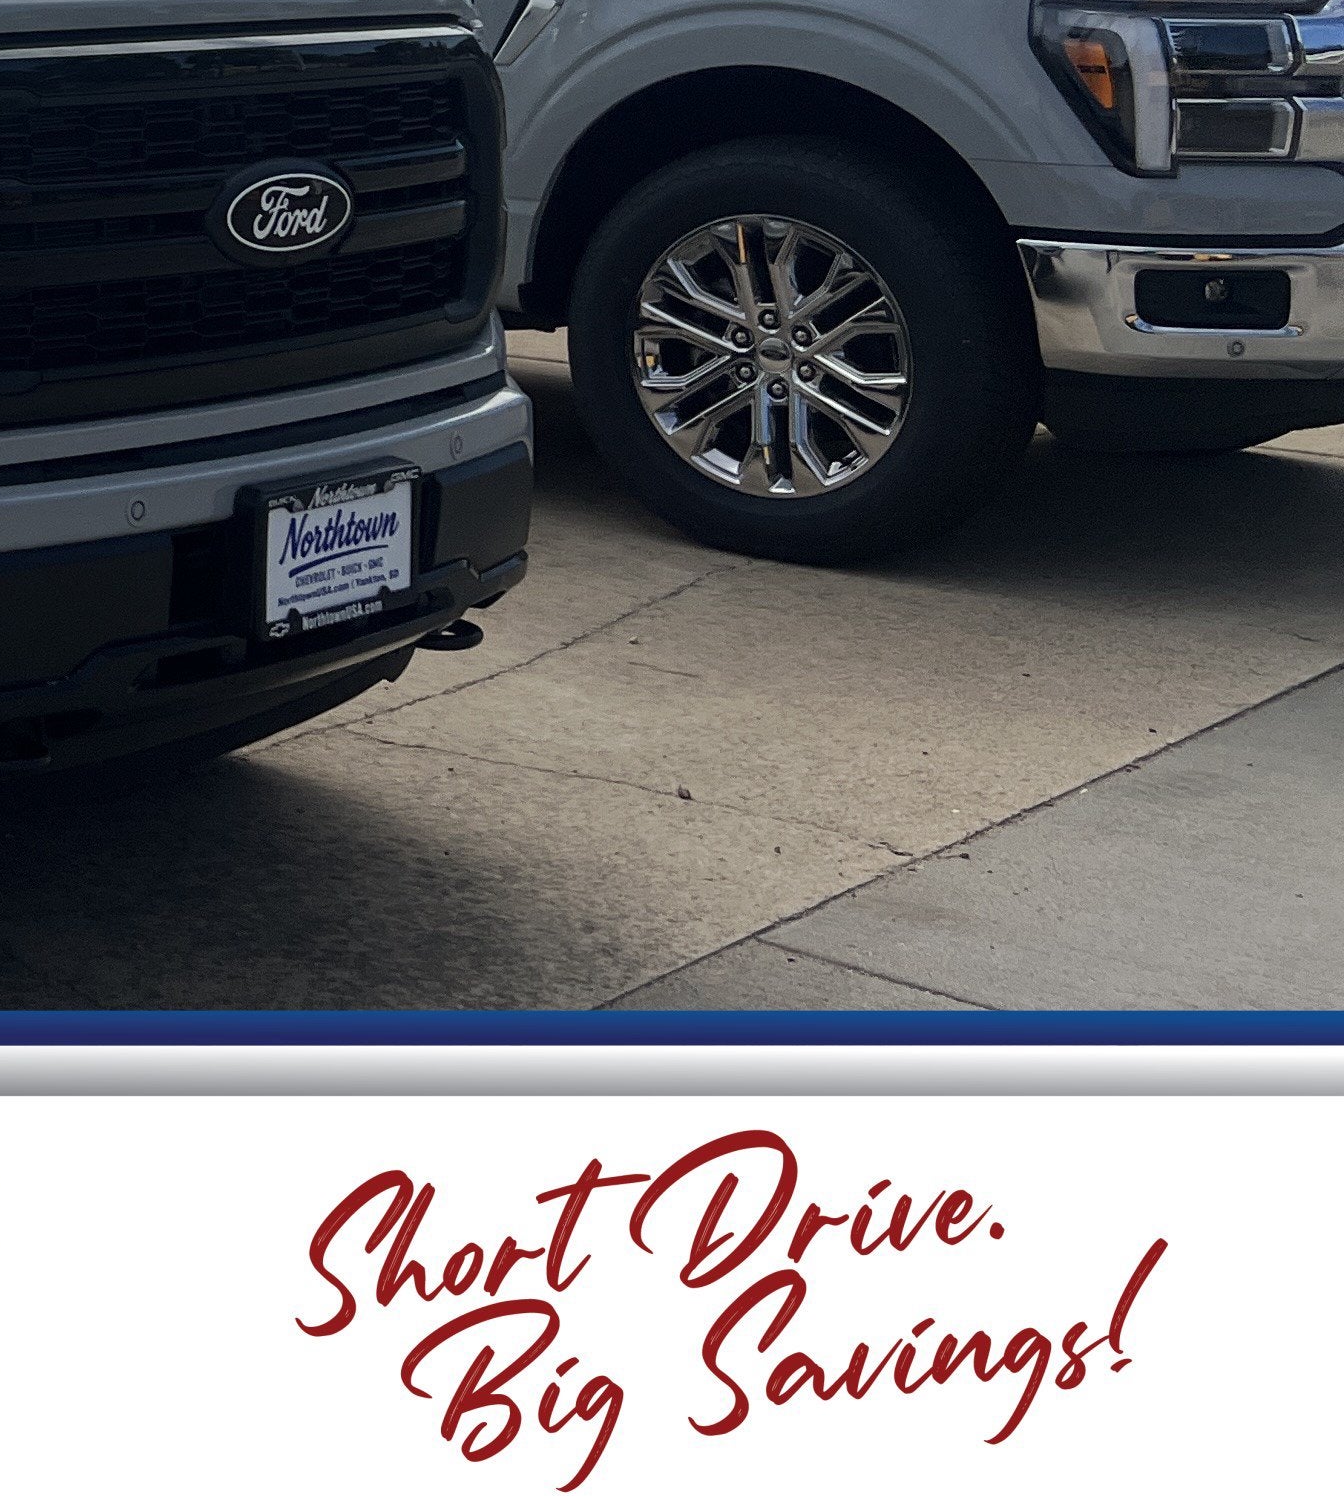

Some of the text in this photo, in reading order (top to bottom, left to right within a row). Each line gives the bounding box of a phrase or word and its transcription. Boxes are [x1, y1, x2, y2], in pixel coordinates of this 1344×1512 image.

[252, 185, 329, 240] Ford
[307, 482, 378, 510] Northtown
[278, 509, 400, 565] Northtown
